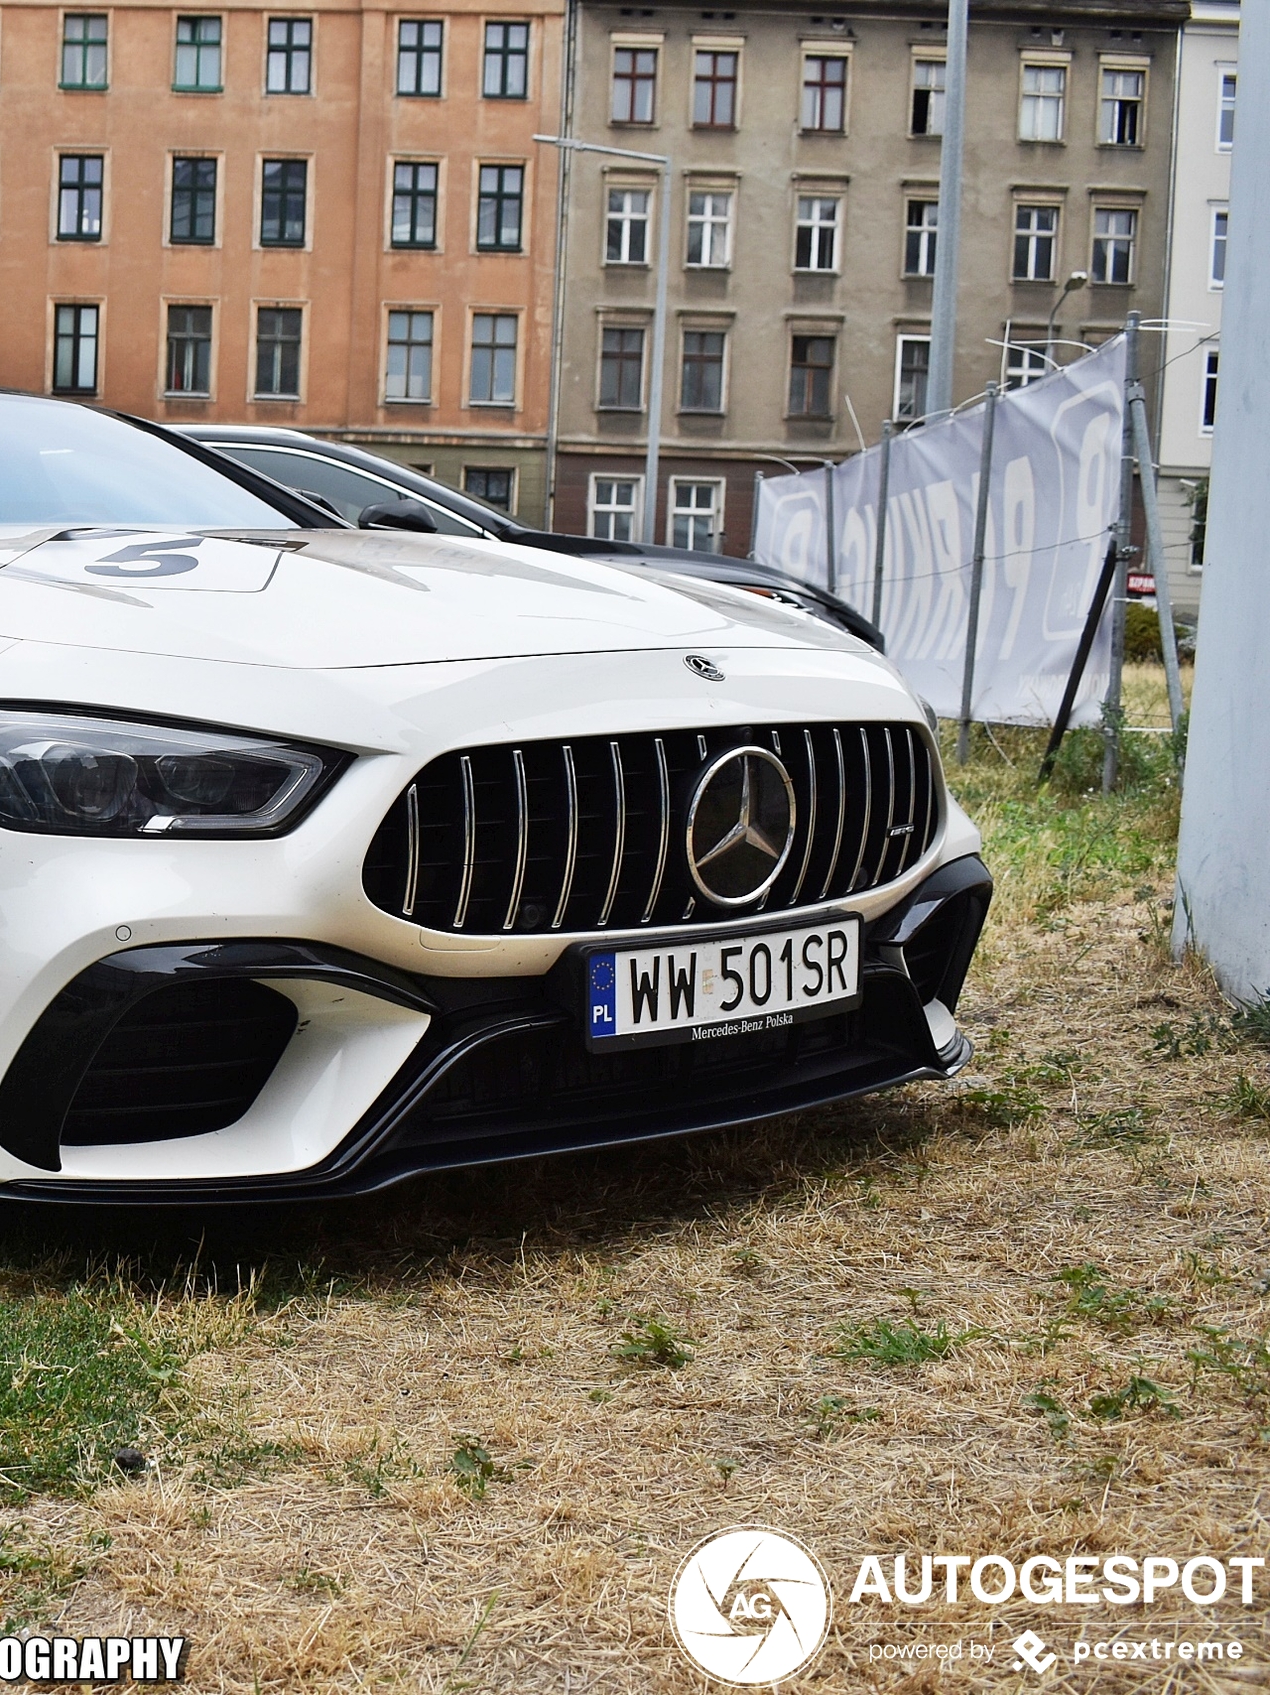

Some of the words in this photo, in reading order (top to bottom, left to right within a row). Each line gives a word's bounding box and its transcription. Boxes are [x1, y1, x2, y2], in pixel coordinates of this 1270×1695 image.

[84, 537, 205, 578] 5
[630, 952, 697, 1024] WW
[720, 930, 848, 1011] 501SR
[593, 1004, 612, 1023] PL
[691, 1020, 764, 1040] Mercedes-Benz
[765, 1013, 794, 1029] Polska
